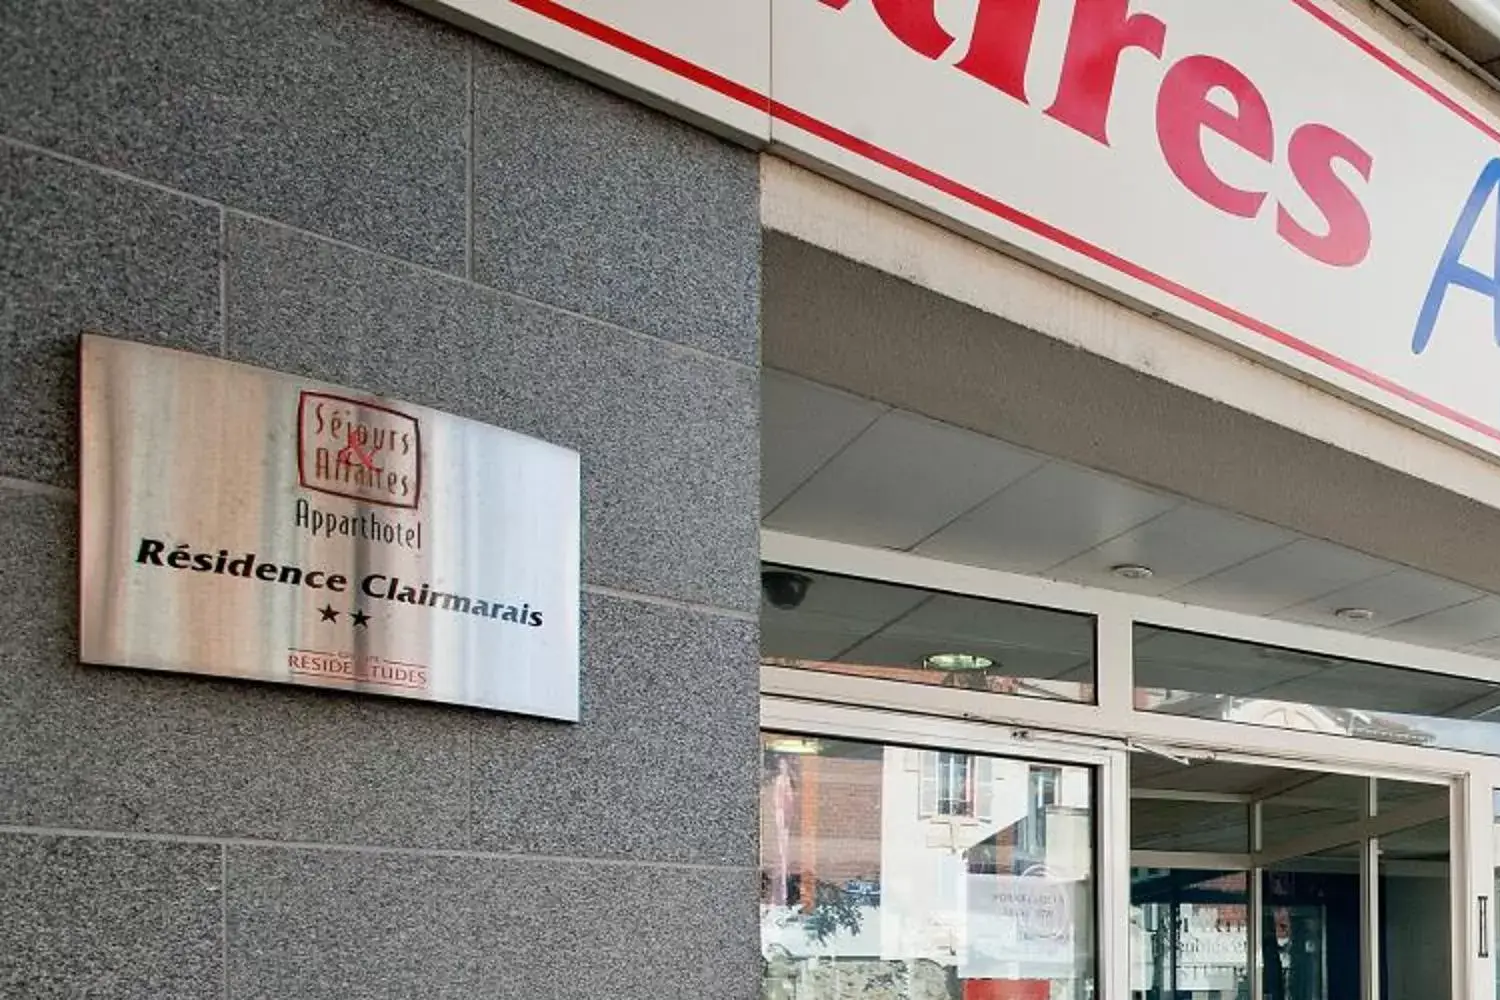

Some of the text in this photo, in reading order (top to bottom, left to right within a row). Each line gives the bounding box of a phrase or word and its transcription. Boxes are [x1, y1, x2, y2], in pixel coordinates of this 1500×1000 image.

[315, 403, 409, 455] Séjours
[316, 448, 409, 497] Affaires
[296, 498, 421, 549] Apparthotel
[135, 538, 544, 628] Résidence Clairmarais
